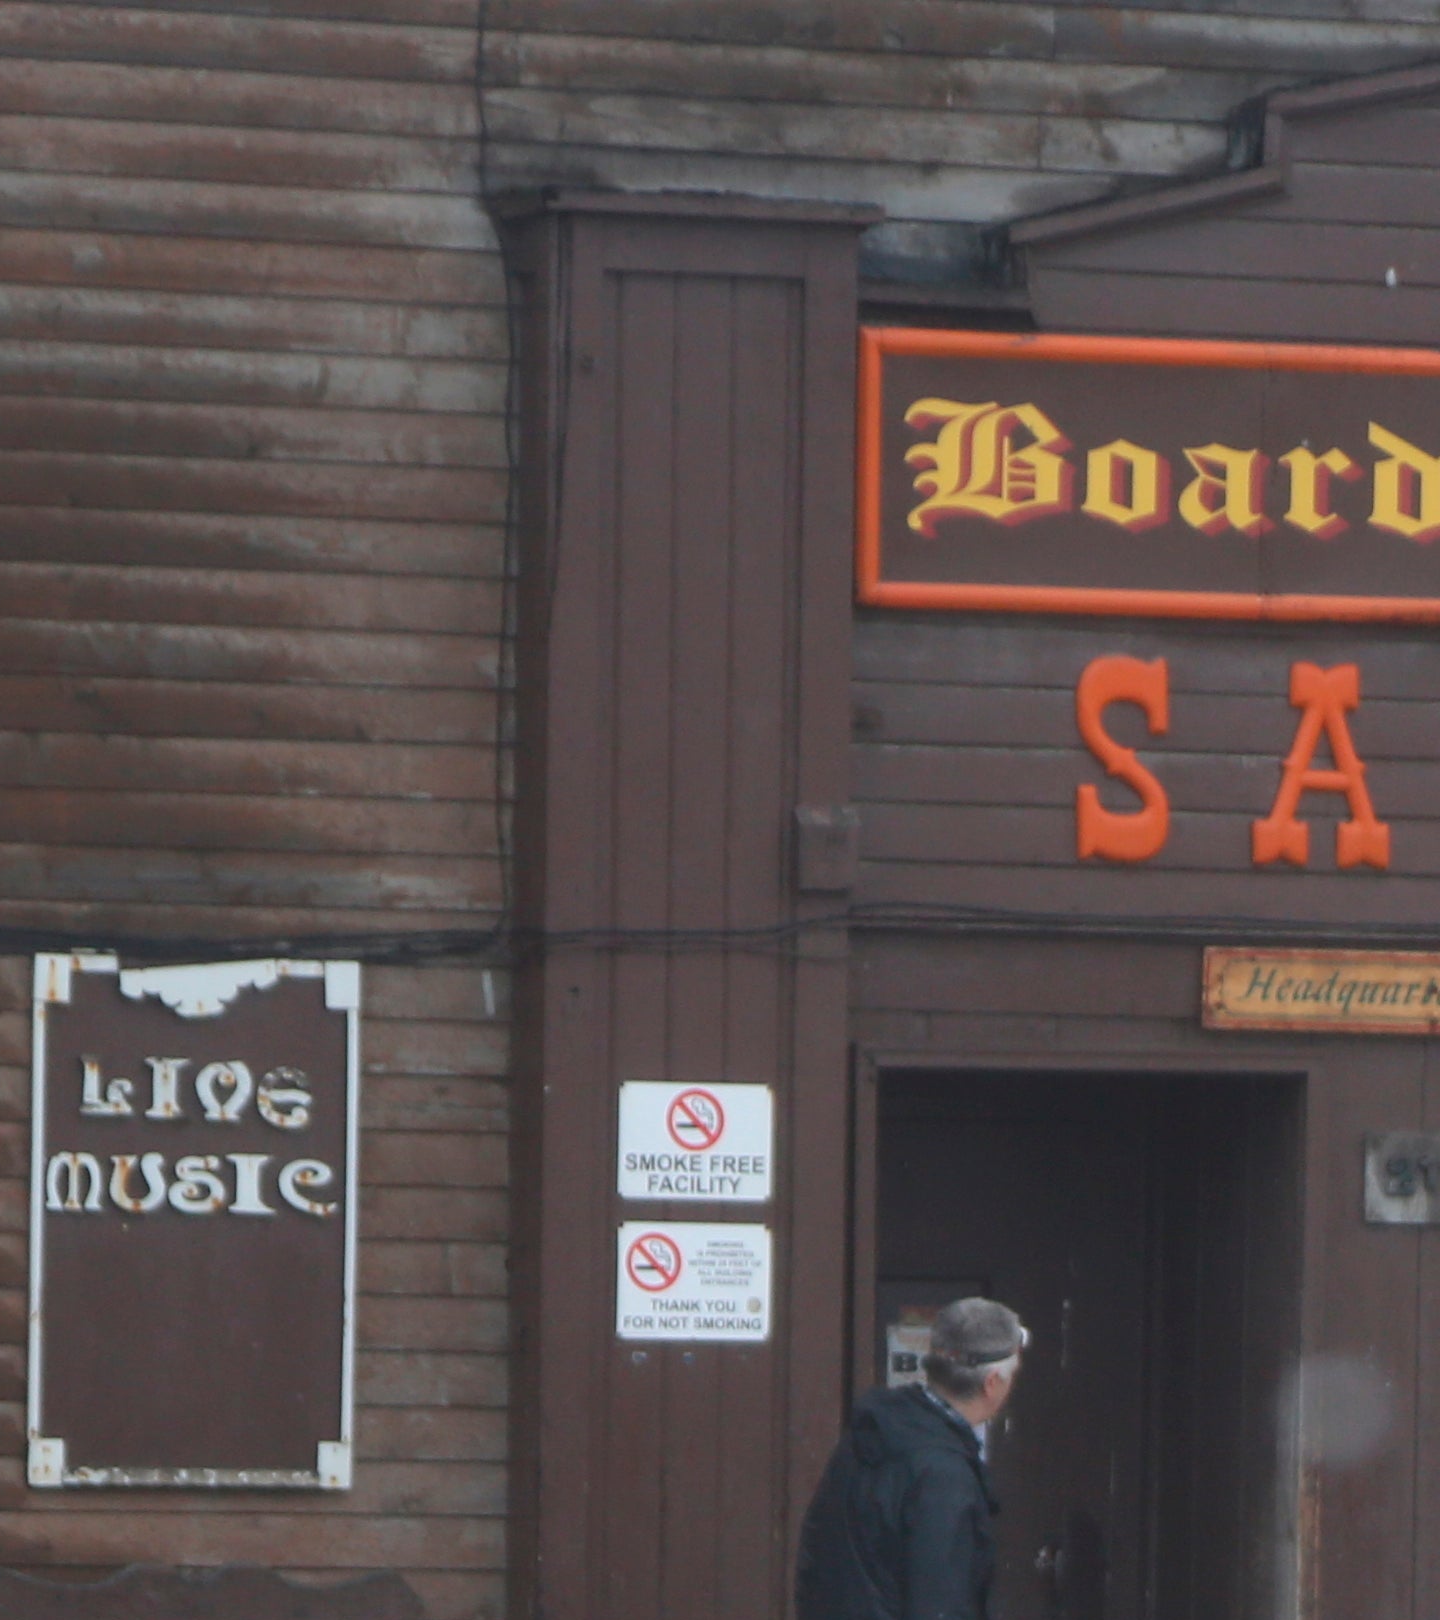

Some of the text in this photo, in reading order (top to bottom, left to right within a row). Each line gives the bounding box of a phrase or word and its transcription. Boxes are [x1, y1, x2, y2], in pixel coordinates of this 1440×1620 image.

[79, 1054, 313, 1129] LIVE
[625, 1153, 765, 1174] SMOKE FREE
[46, 1152, 339, 1216] MUSIC
[647, 1175, 741, 1194] FACILITY
[650, 1298, 736, 1313] THANK YOU
[623, 1315, 762, 1331] FOR NOT SMOKING
